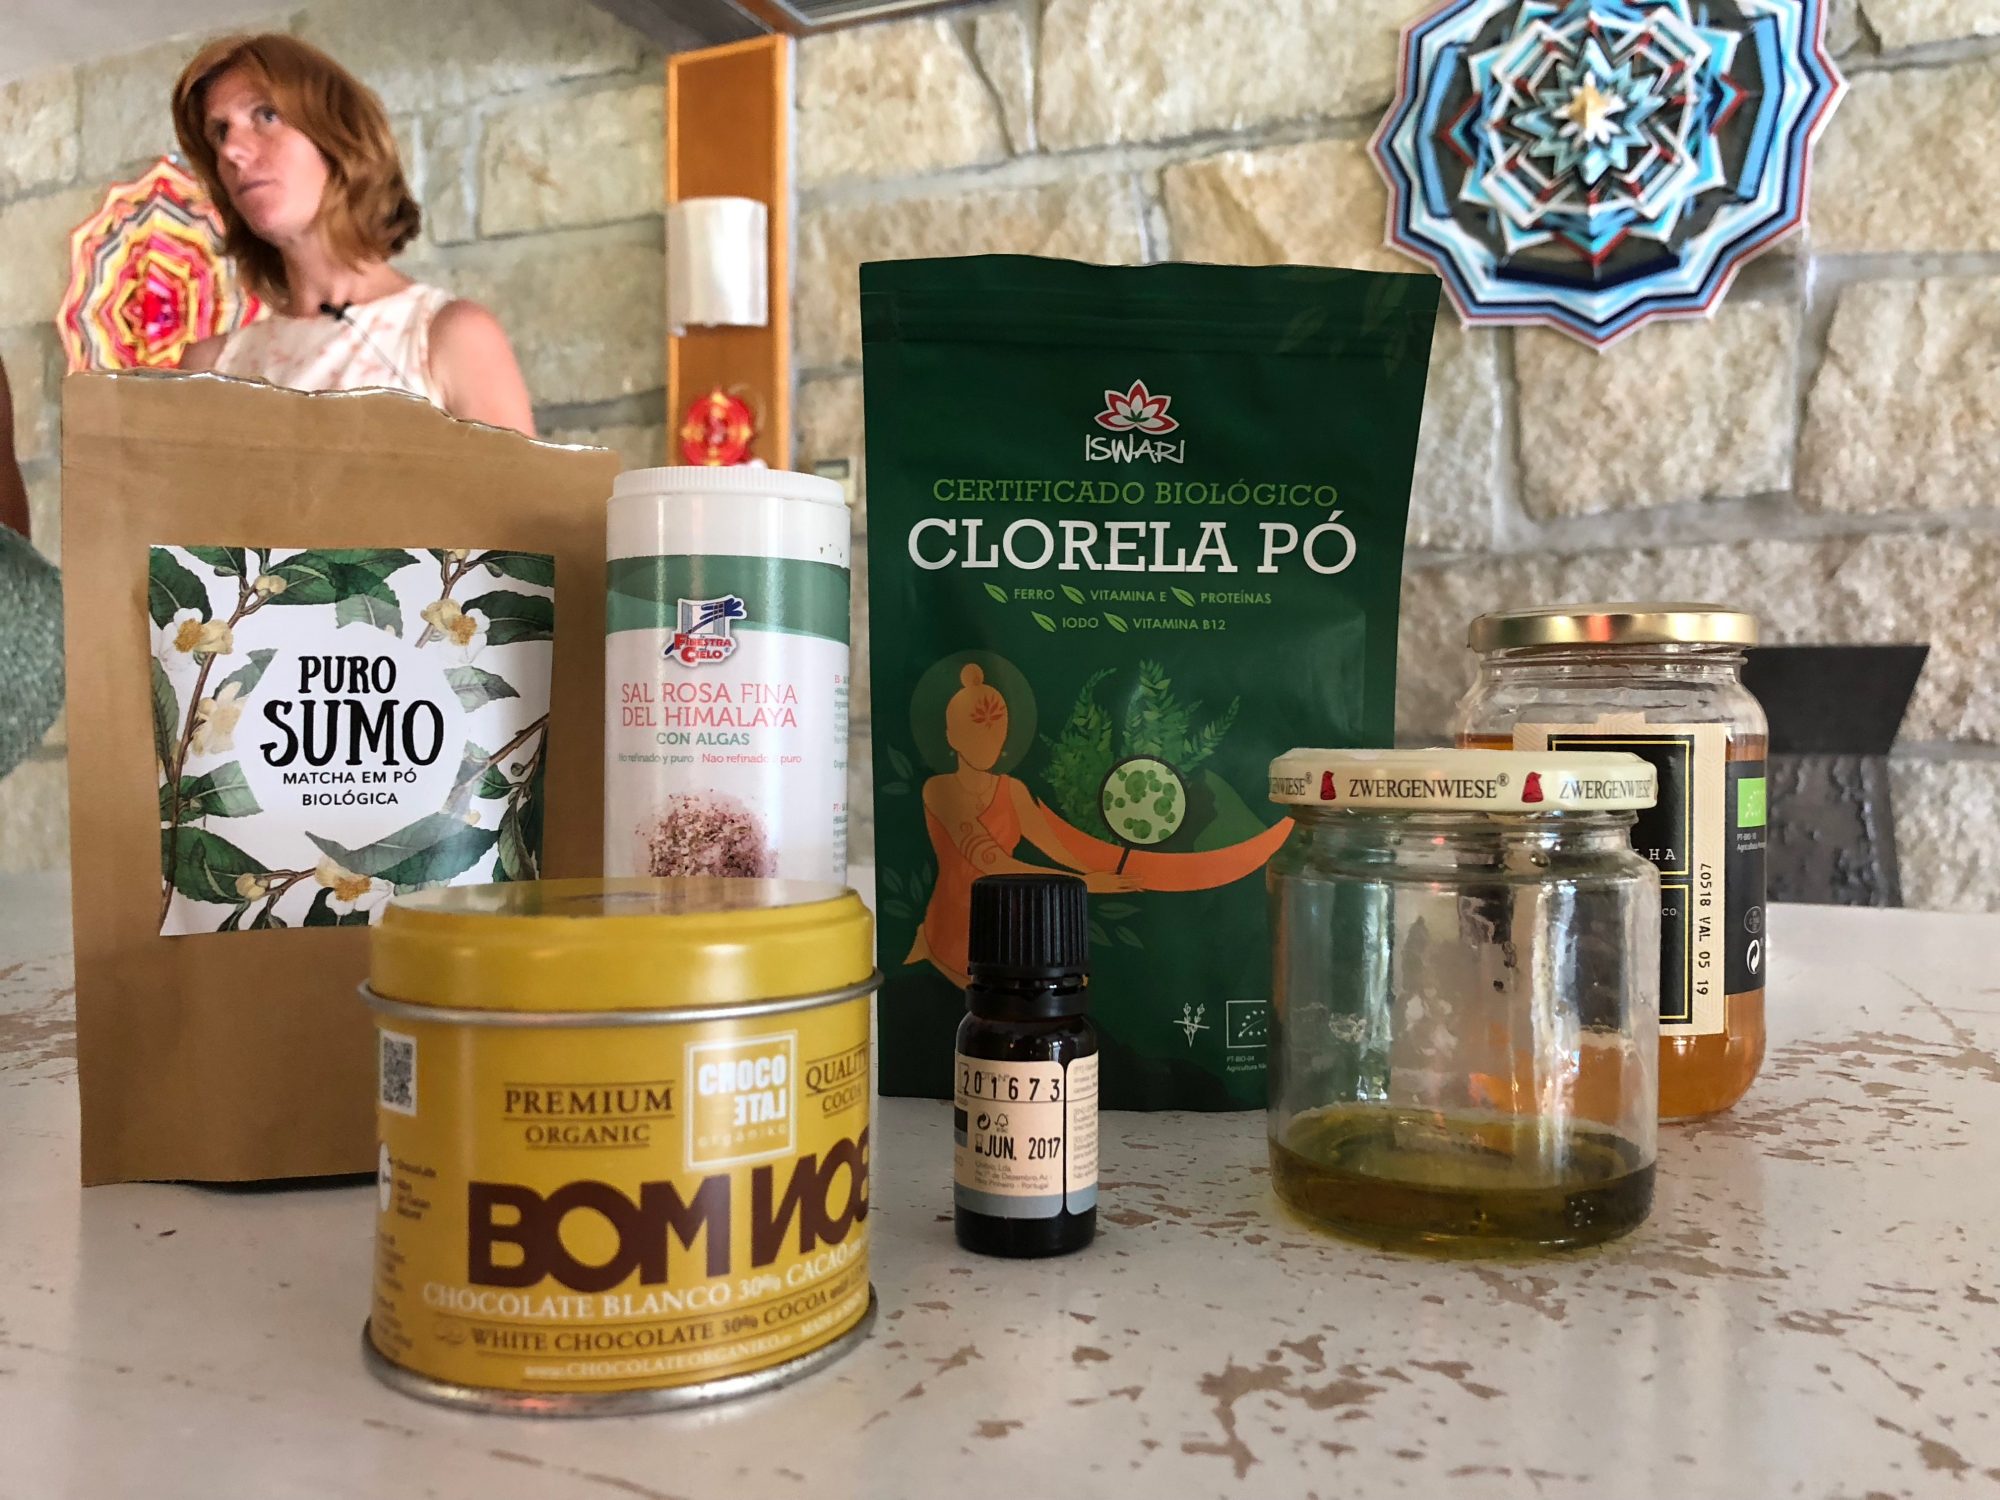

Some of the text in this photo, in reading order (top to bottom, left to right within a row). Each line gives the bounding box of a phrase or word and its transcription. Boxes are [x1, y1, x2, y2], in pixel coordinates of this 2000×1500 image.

[1085, 433, 1185, 464] ISWARI
[932, 478, 1338, 508] CERTIFICADO BIOLÓGICO
[908, 510, 1357, 575] CLORELA PÓ
[1014, 588, 1272, 605] FERRO VITAMINA E PROTEÍNAS
[1062, 617, 1226, 631] IODO VITAMINA B12
[681, 646, 723, 663] CIELO
[298, 655, 396, 694] PURO
[622, 682, 798, 704] SAL ROSA FINA
[622, 706, 797, 727] DEL HIMALAYA
[260, 700, 444, 767] SUMO
[656, 732, 750, 745] CON ALGAS
[662, 754, 670, 765] y
[671, 754, 694, 765] puro
[283, 767, 417, 785] MATCHA EM PÓ
[302, 789, 398, 807] BIOLÓGICA
[1698, 917, 1711, 941] VAL
[1698, 951, 1711, 968] 05
[1696, 980, 1710, 996] 19
[699, 1054, 787, 1096] CHOCO
[505, 1087, 673, 1115] PREMIUM
[525, 1123, 651, 1144] ORGANIC
[1028, 1136, 1061, 1160] 2017
[468, 1173, 731, 1293] BOM
[423, 1281, 595, 1320] CHOCOLATE
[602, 1282, 731, 1318] BLANCO
[786, 1242, 848, 1287] CACAO
[471, 1326, 548, 1351] WHITE
[554, 1319, 714, 1352] CHOCOLATE
[764, 1289, 827, 1326] COCOA
